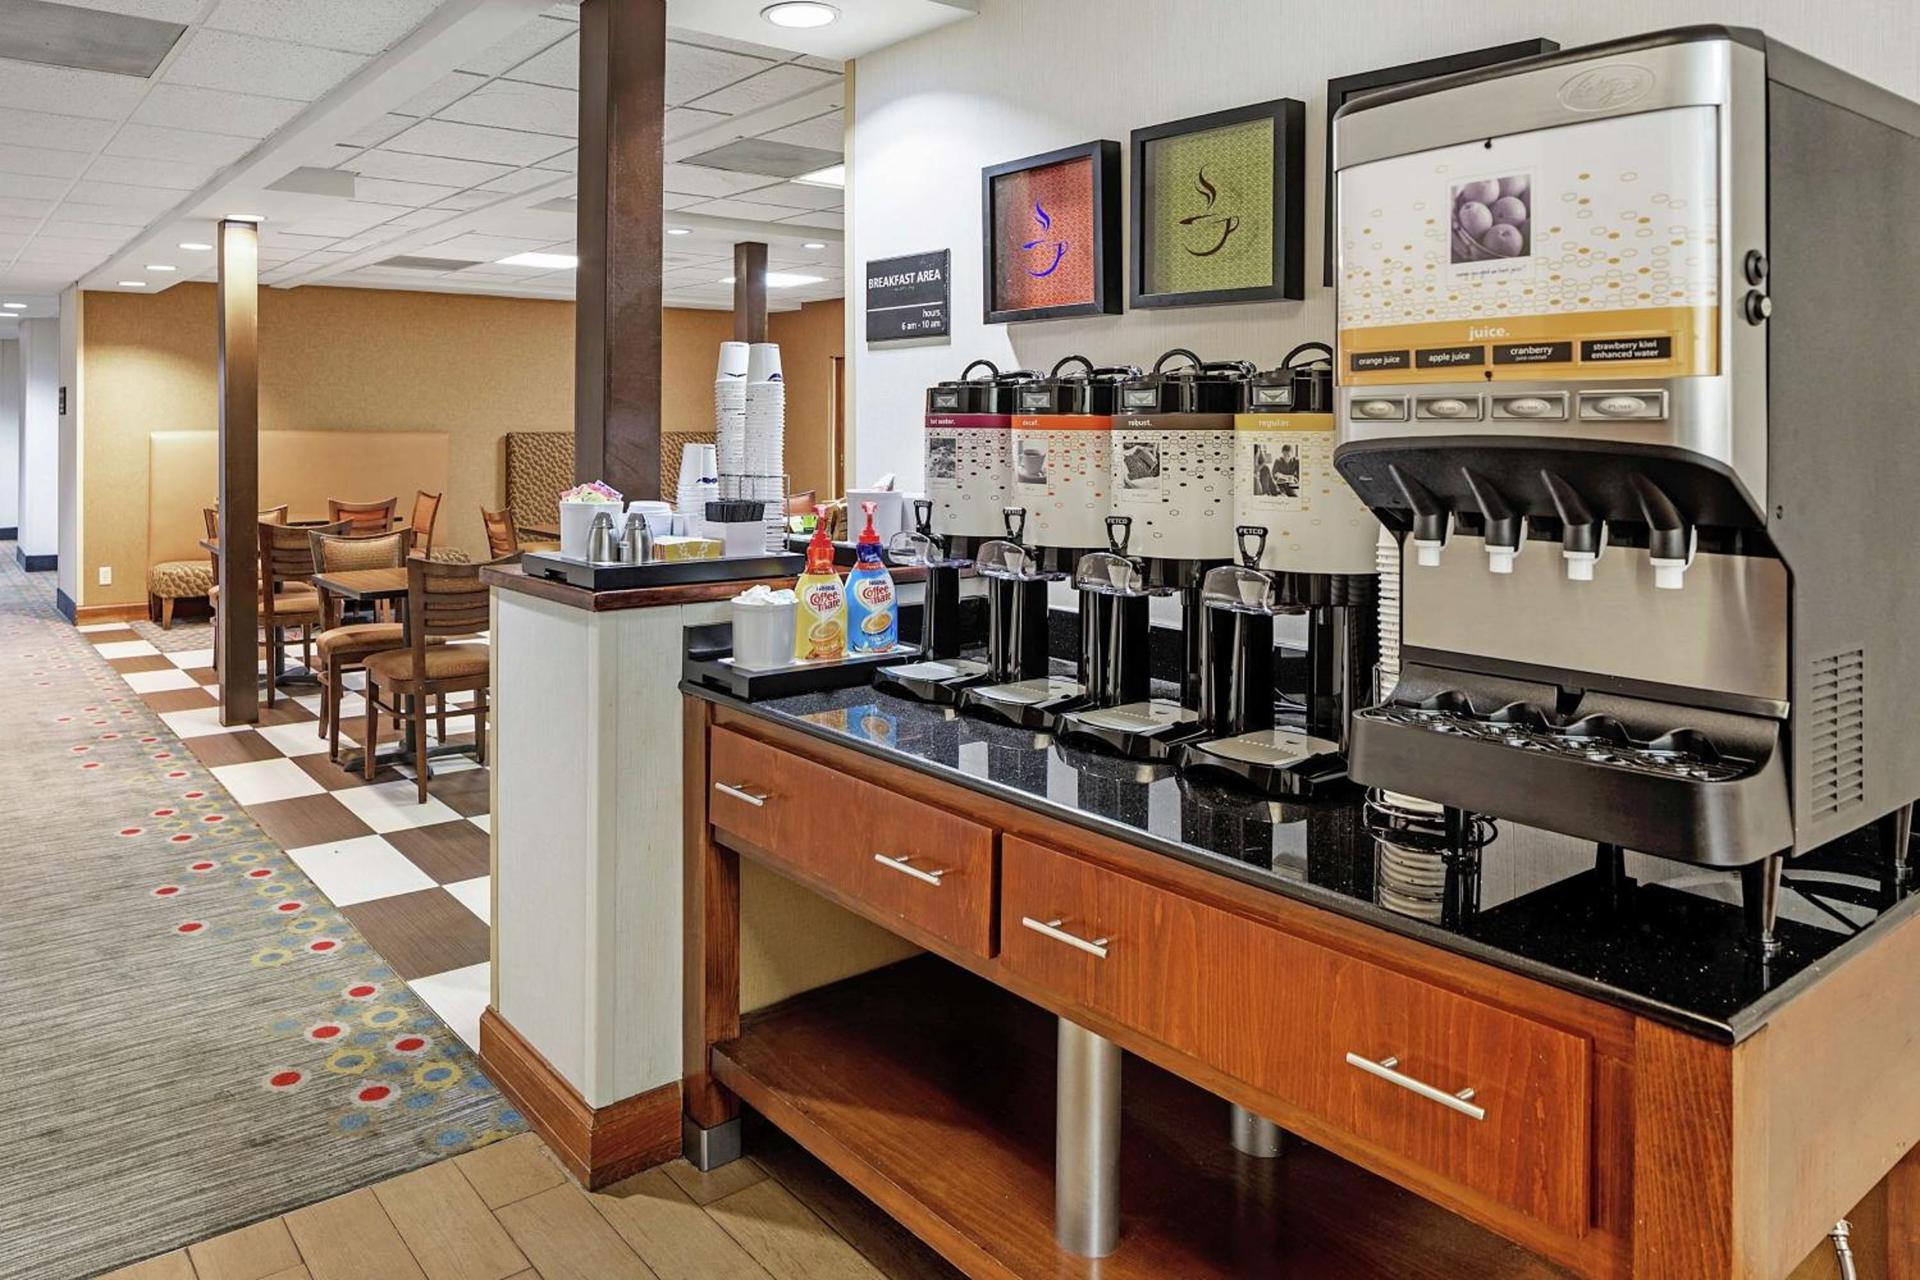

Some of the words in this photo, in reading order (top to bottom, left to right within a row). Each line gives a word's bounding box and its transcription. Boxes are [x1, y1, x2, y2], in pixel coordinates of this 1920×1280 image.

[868, 272, 915, 289] BREAKFAST
[916, 269, 941, 282] AREA
[901, 322, 906, 331] 6
[907, 322, 917, 330] am
[922, 320, 930, 329] 10
[1468, 326, 1510, 341] juice.
[1510, 345, 1553, 355] cranberry
[1593, 341, 1638, 351] strawberry
[1639, 340, 1657, 348] kiwi
[1428, 353, 1450, 363] apple
[1450, 351, 1470, 361] juice
[1591, 350, 1633, 359] enhanced
[1634, 349, 1659, 357] water
[1358, 357, 1383, 366] orange
[1383, 355, 1401, 364] juice
